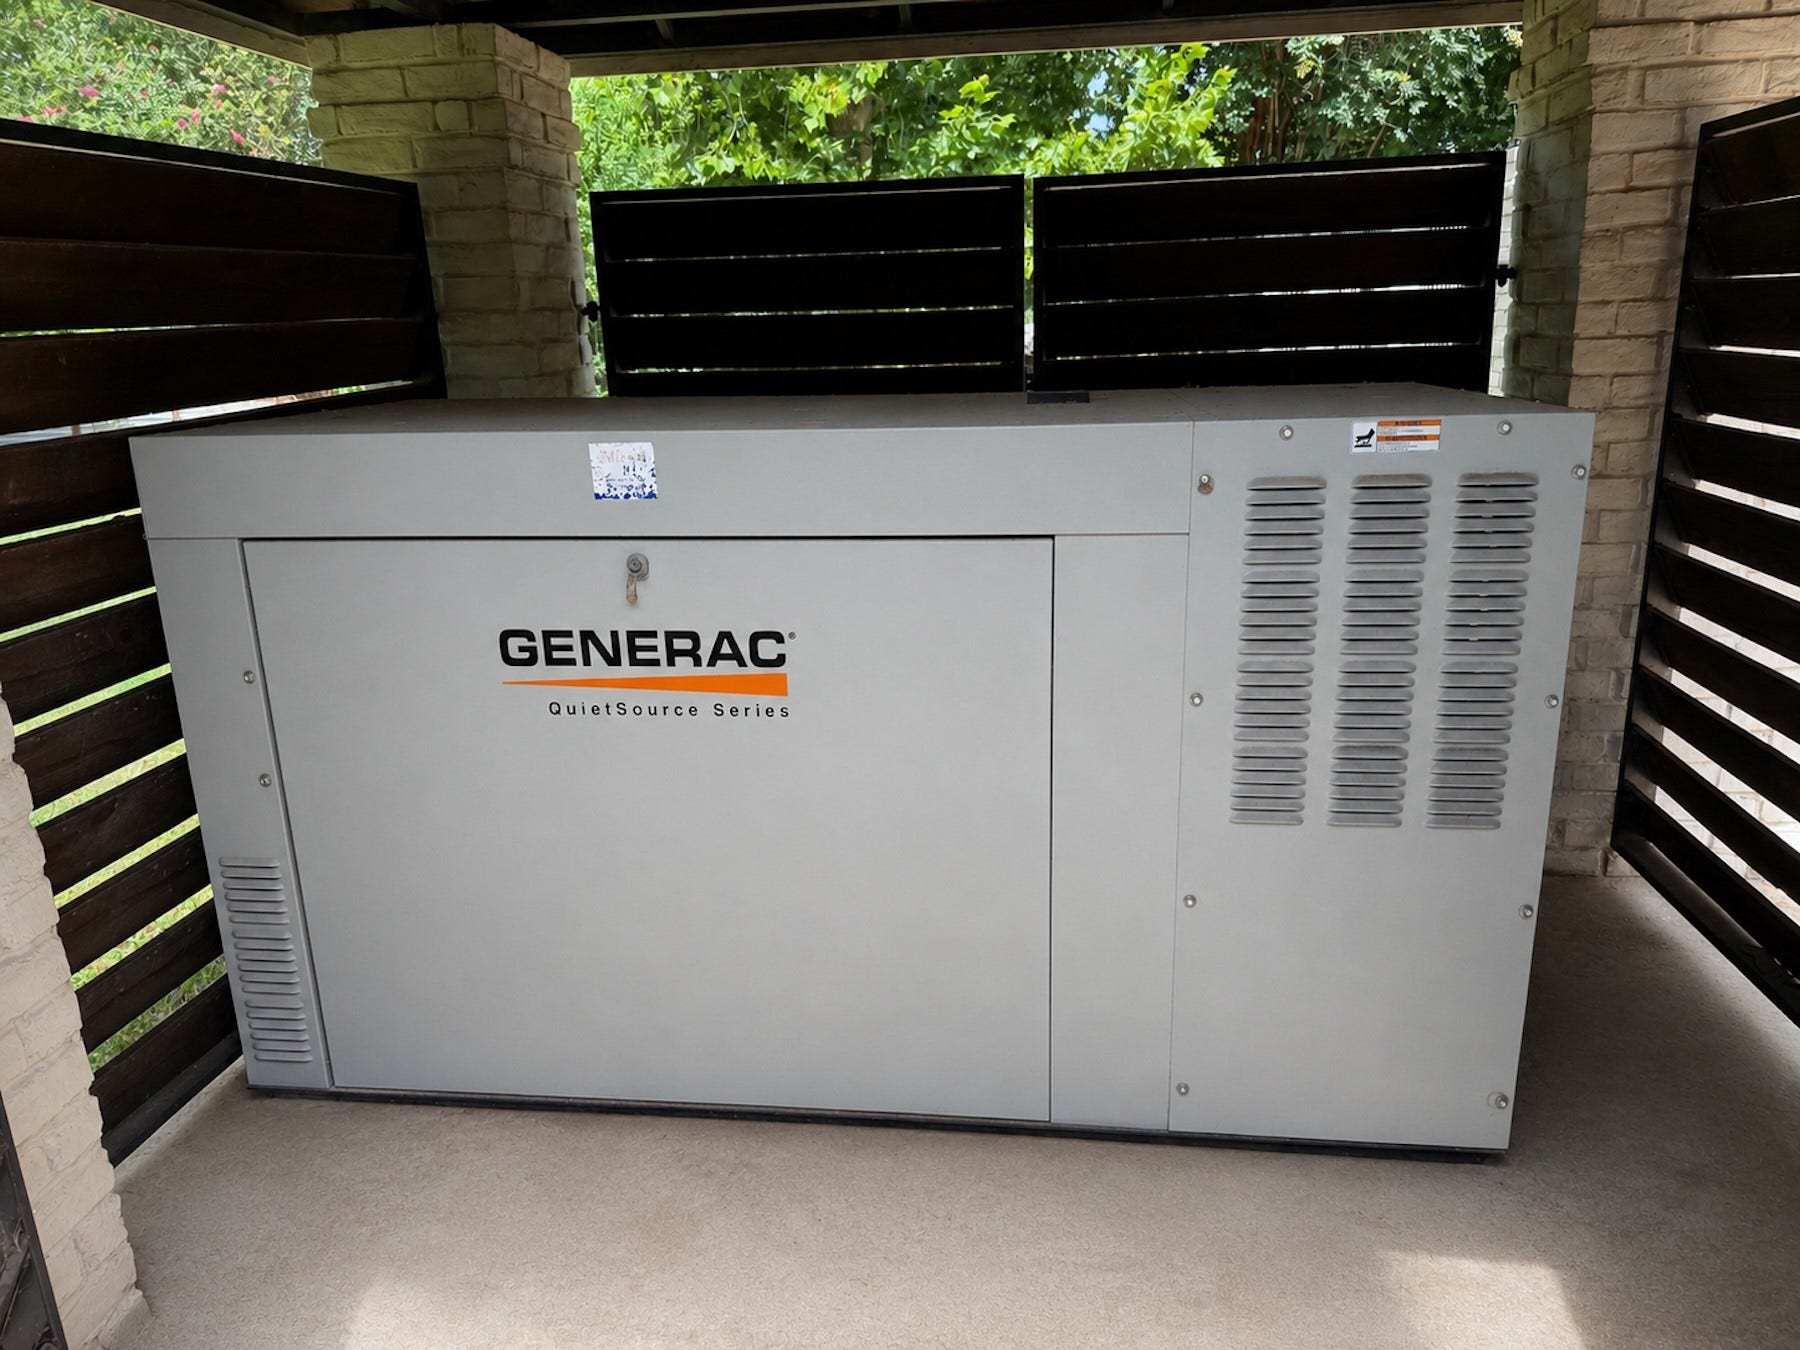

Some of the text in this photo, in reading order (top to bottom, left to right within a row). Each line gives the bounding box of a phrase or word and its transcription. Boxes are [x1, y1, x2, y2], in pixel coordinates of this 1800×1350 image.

[499, 628, 787, 668] GENERAC
[548, 701, 789, 718] QuietSource Series
